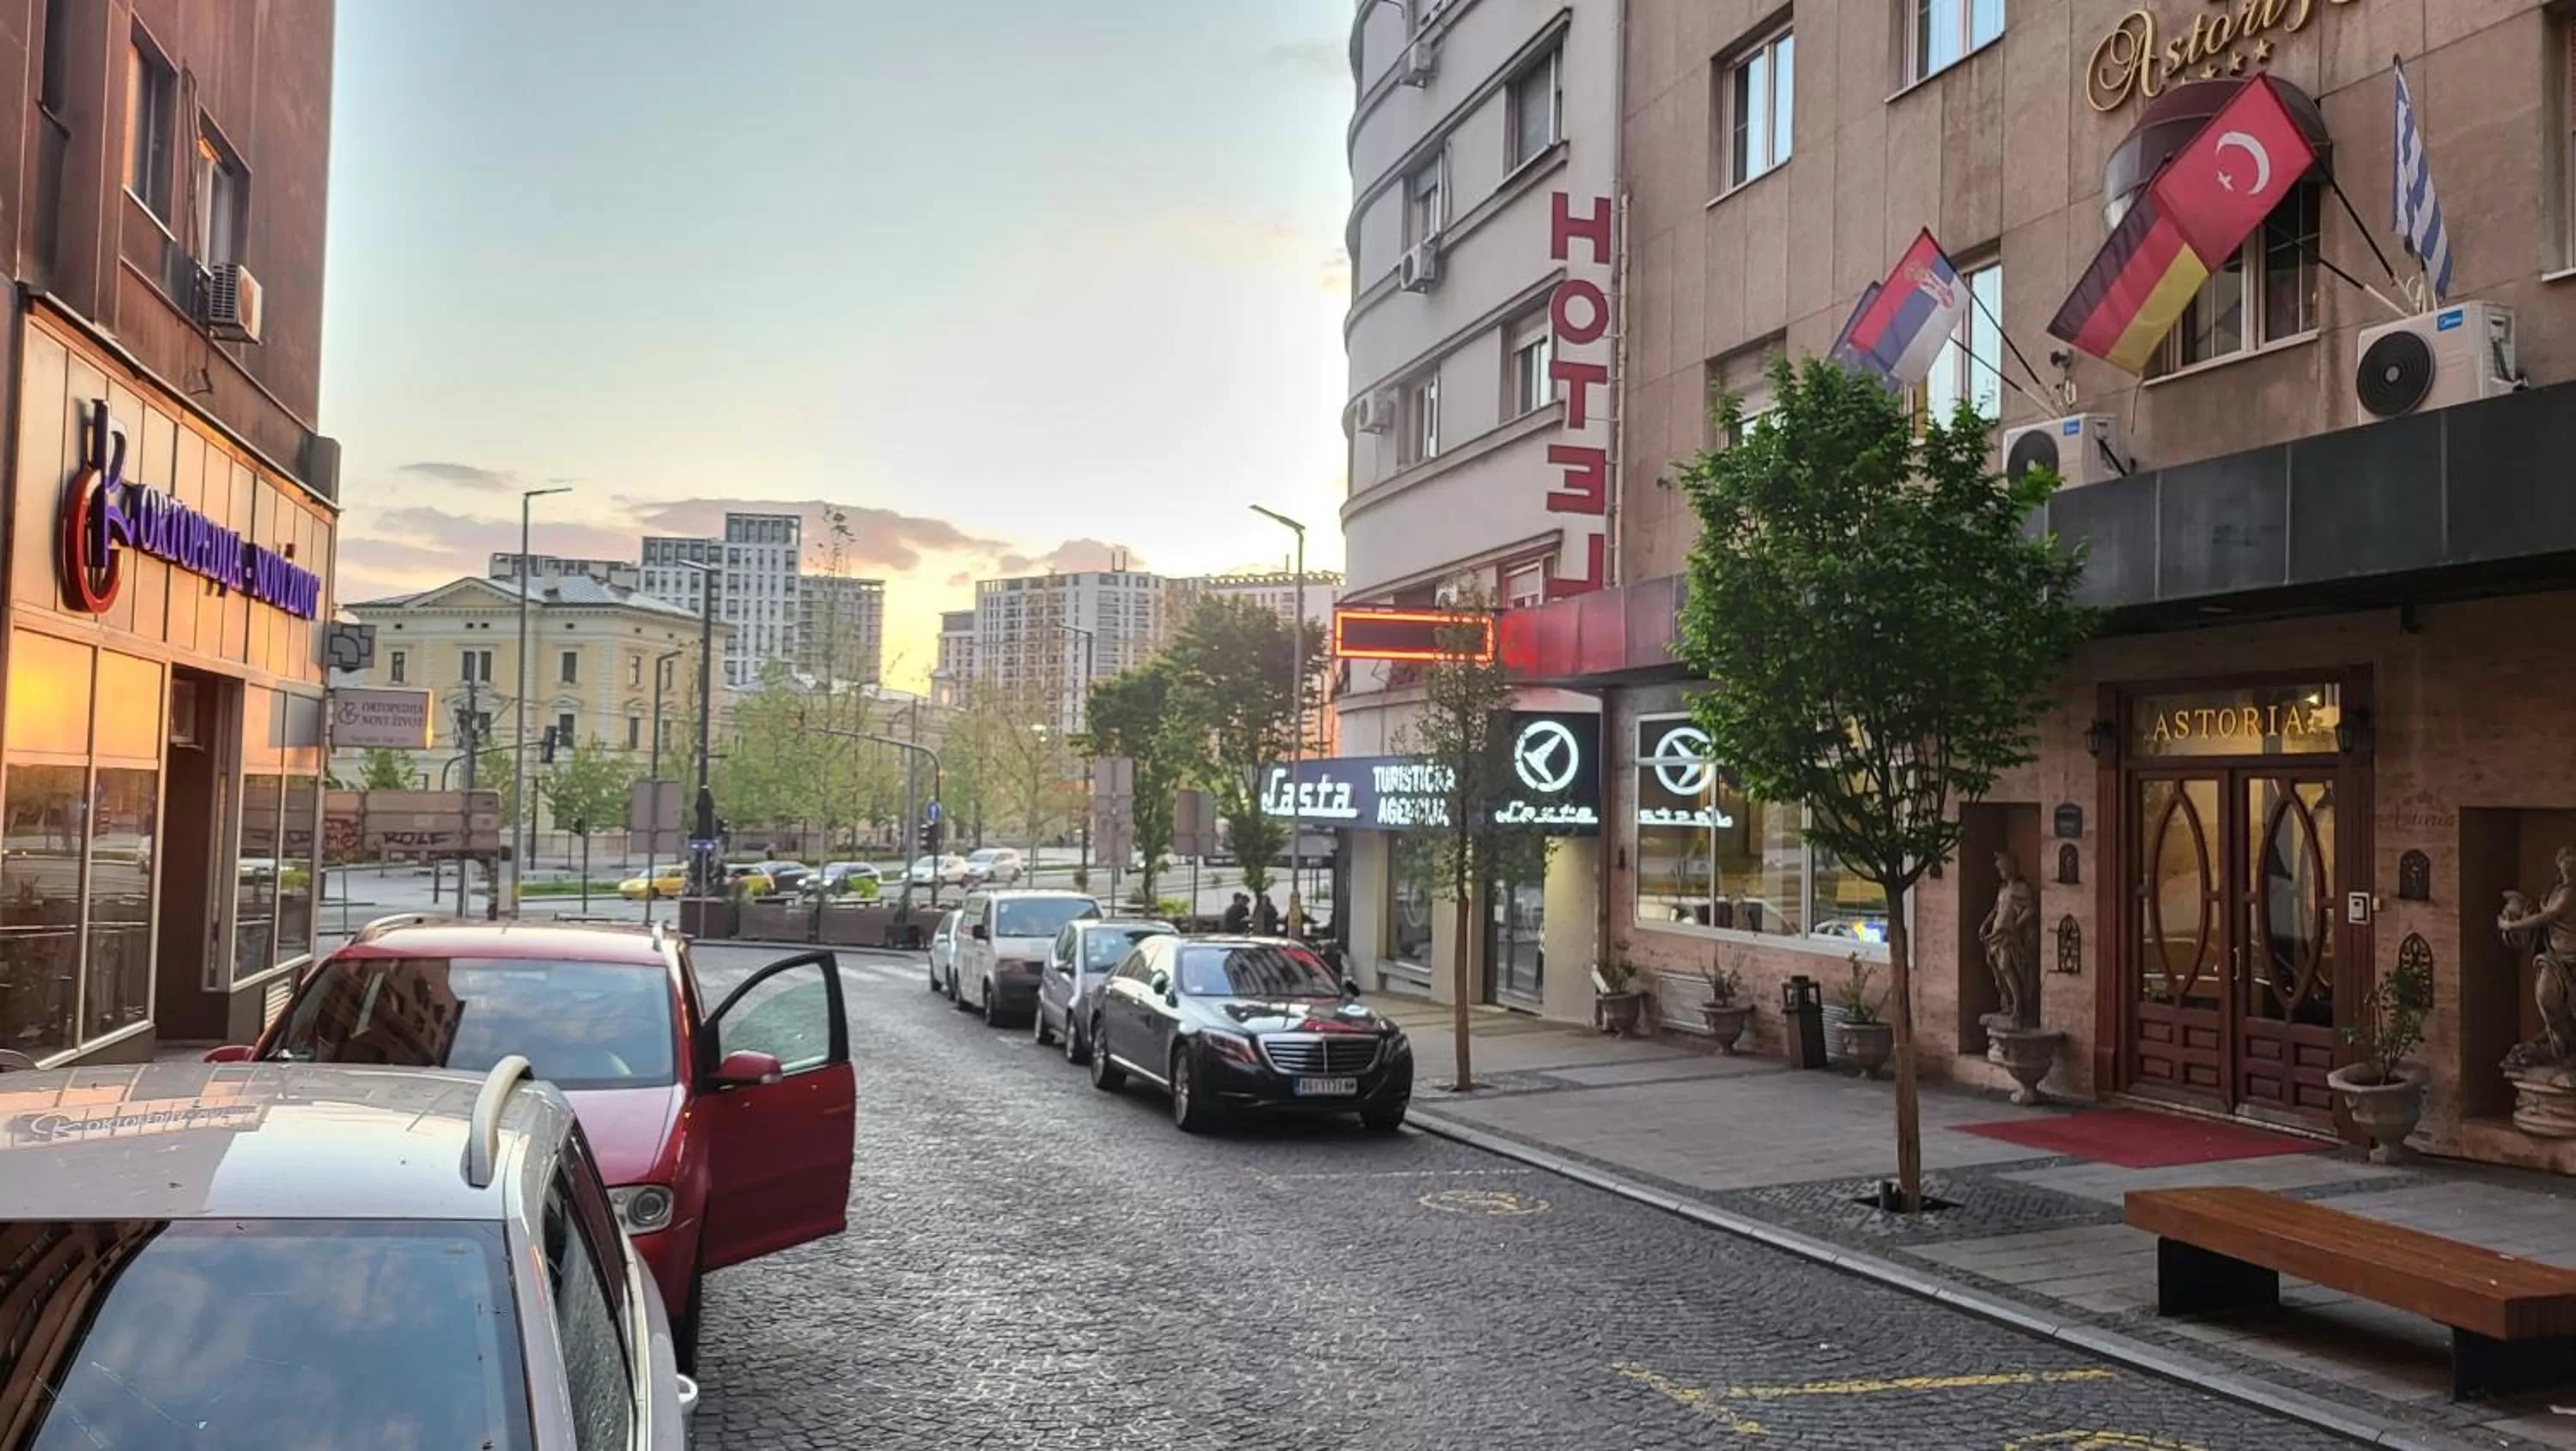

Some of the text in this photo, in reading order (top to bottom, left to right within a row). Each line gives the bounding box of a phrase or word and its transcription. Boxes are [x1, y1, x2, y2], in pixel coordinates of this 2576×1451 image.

[2087, 0, 2310, 111] Astori
[140, 484, 242, 592] ORTOPEDIJA
[2153, 704, 2305, 743] ASTORIA
[1261, 768, 1359, 819] Lasta
